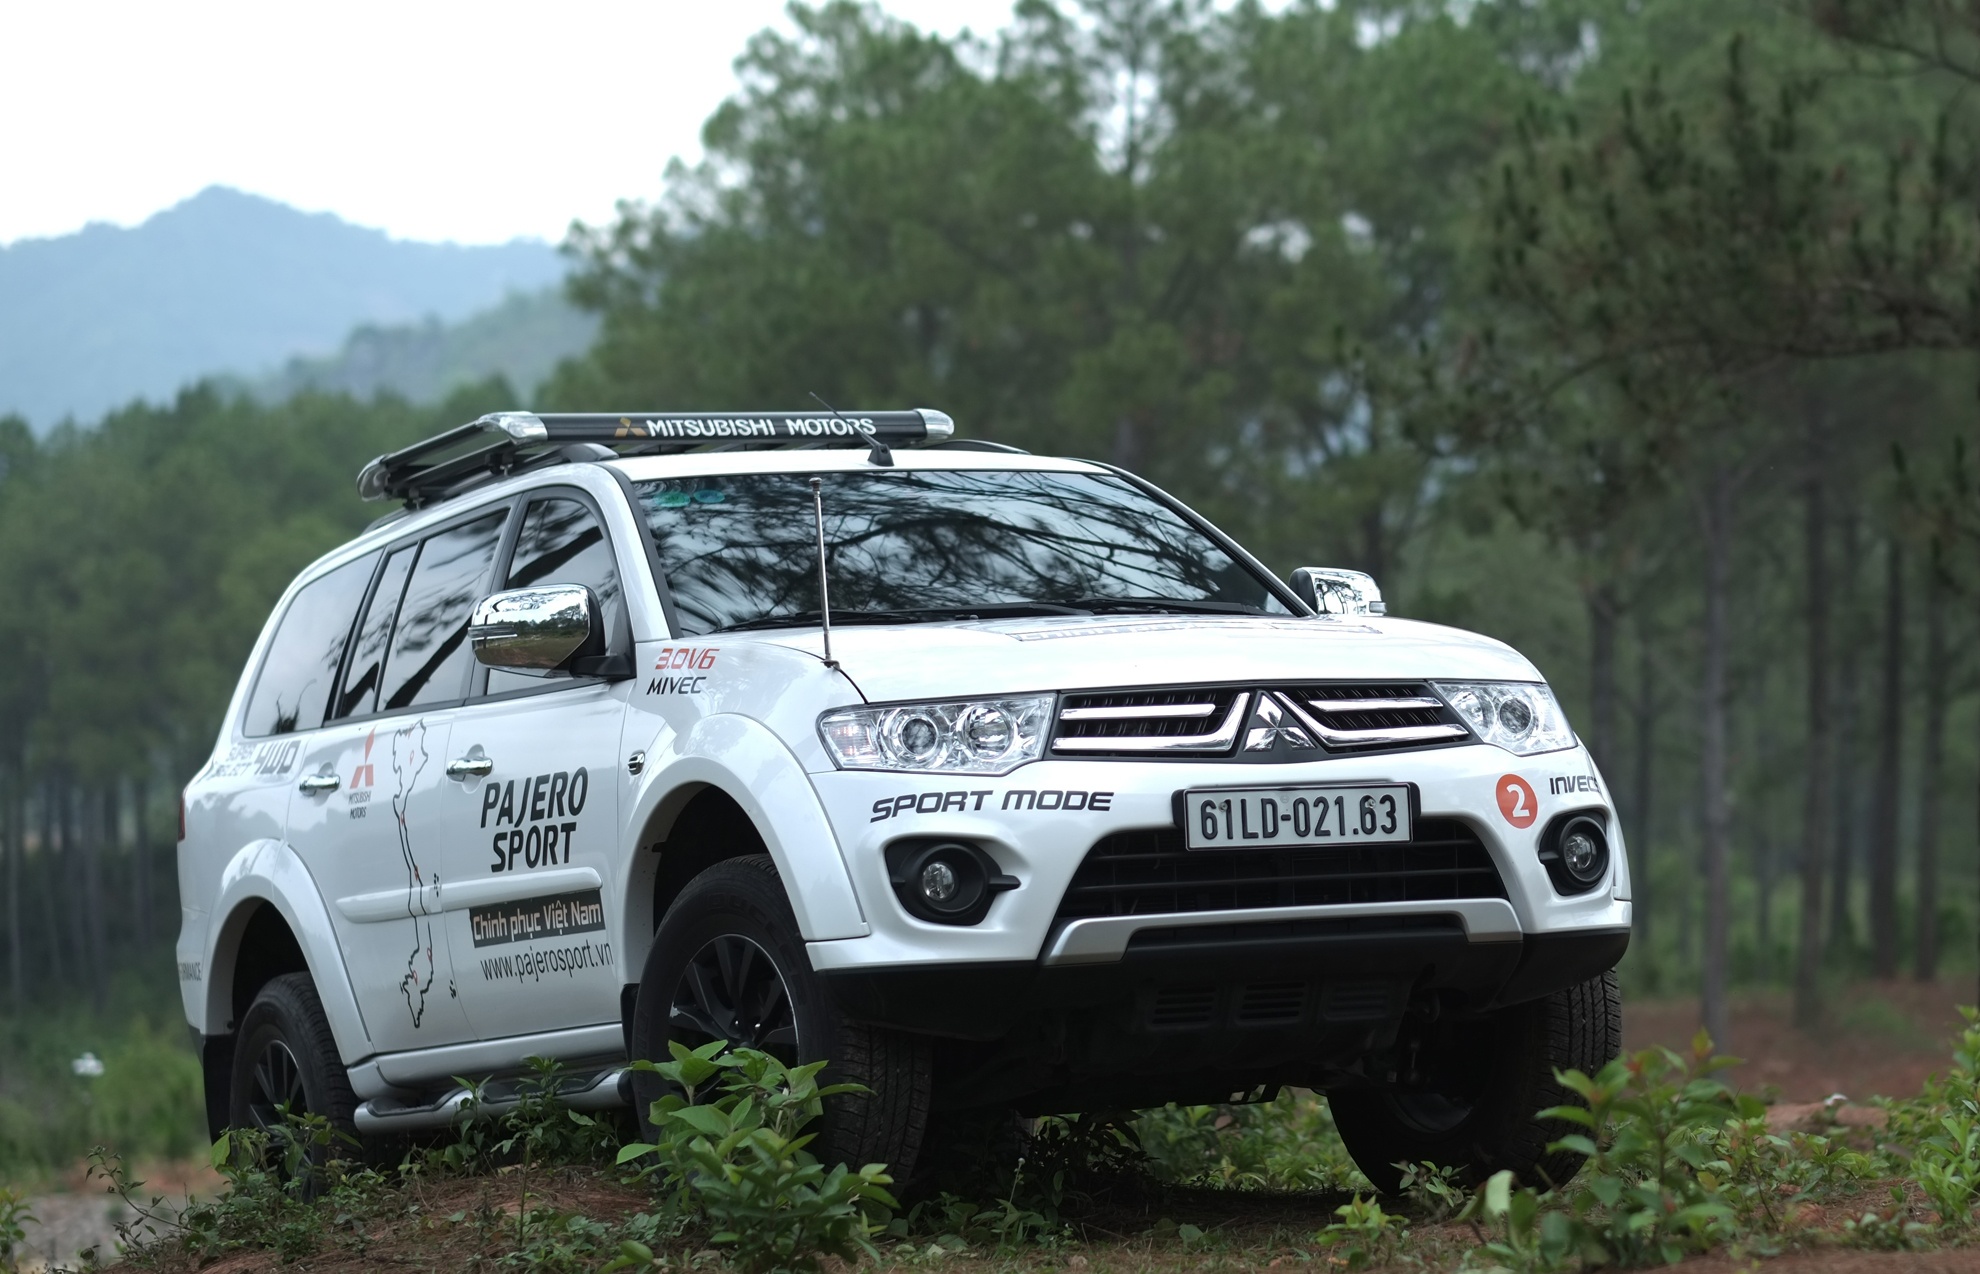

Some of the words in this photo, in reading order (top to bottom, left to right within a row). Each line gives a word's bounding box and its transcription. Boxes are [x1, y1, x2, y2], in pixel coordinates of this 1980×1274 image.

[646, 419, 776, 437] MITSUBISHI
[785, 418, 877, 436] MOTORS
[646, 676, 707, 695] MIVEC
[480, 766, 588, 829] PAJERO
[1506, 783, 1530, 818] 2
[1549, 775, 1600, 795] INVEC
[870, 790, 994, 823] SPORT
[1001, 789, 1115, 812] MODE
[1200, 794, 1398, 841] 61LD-021.63
[490, 821, 577, 873] SPORT
[472, 911, 508, 941] Chinh
[570, 900, 602, 927] Nam
[480, 939, 614, 983] www.pajerosport.vn
